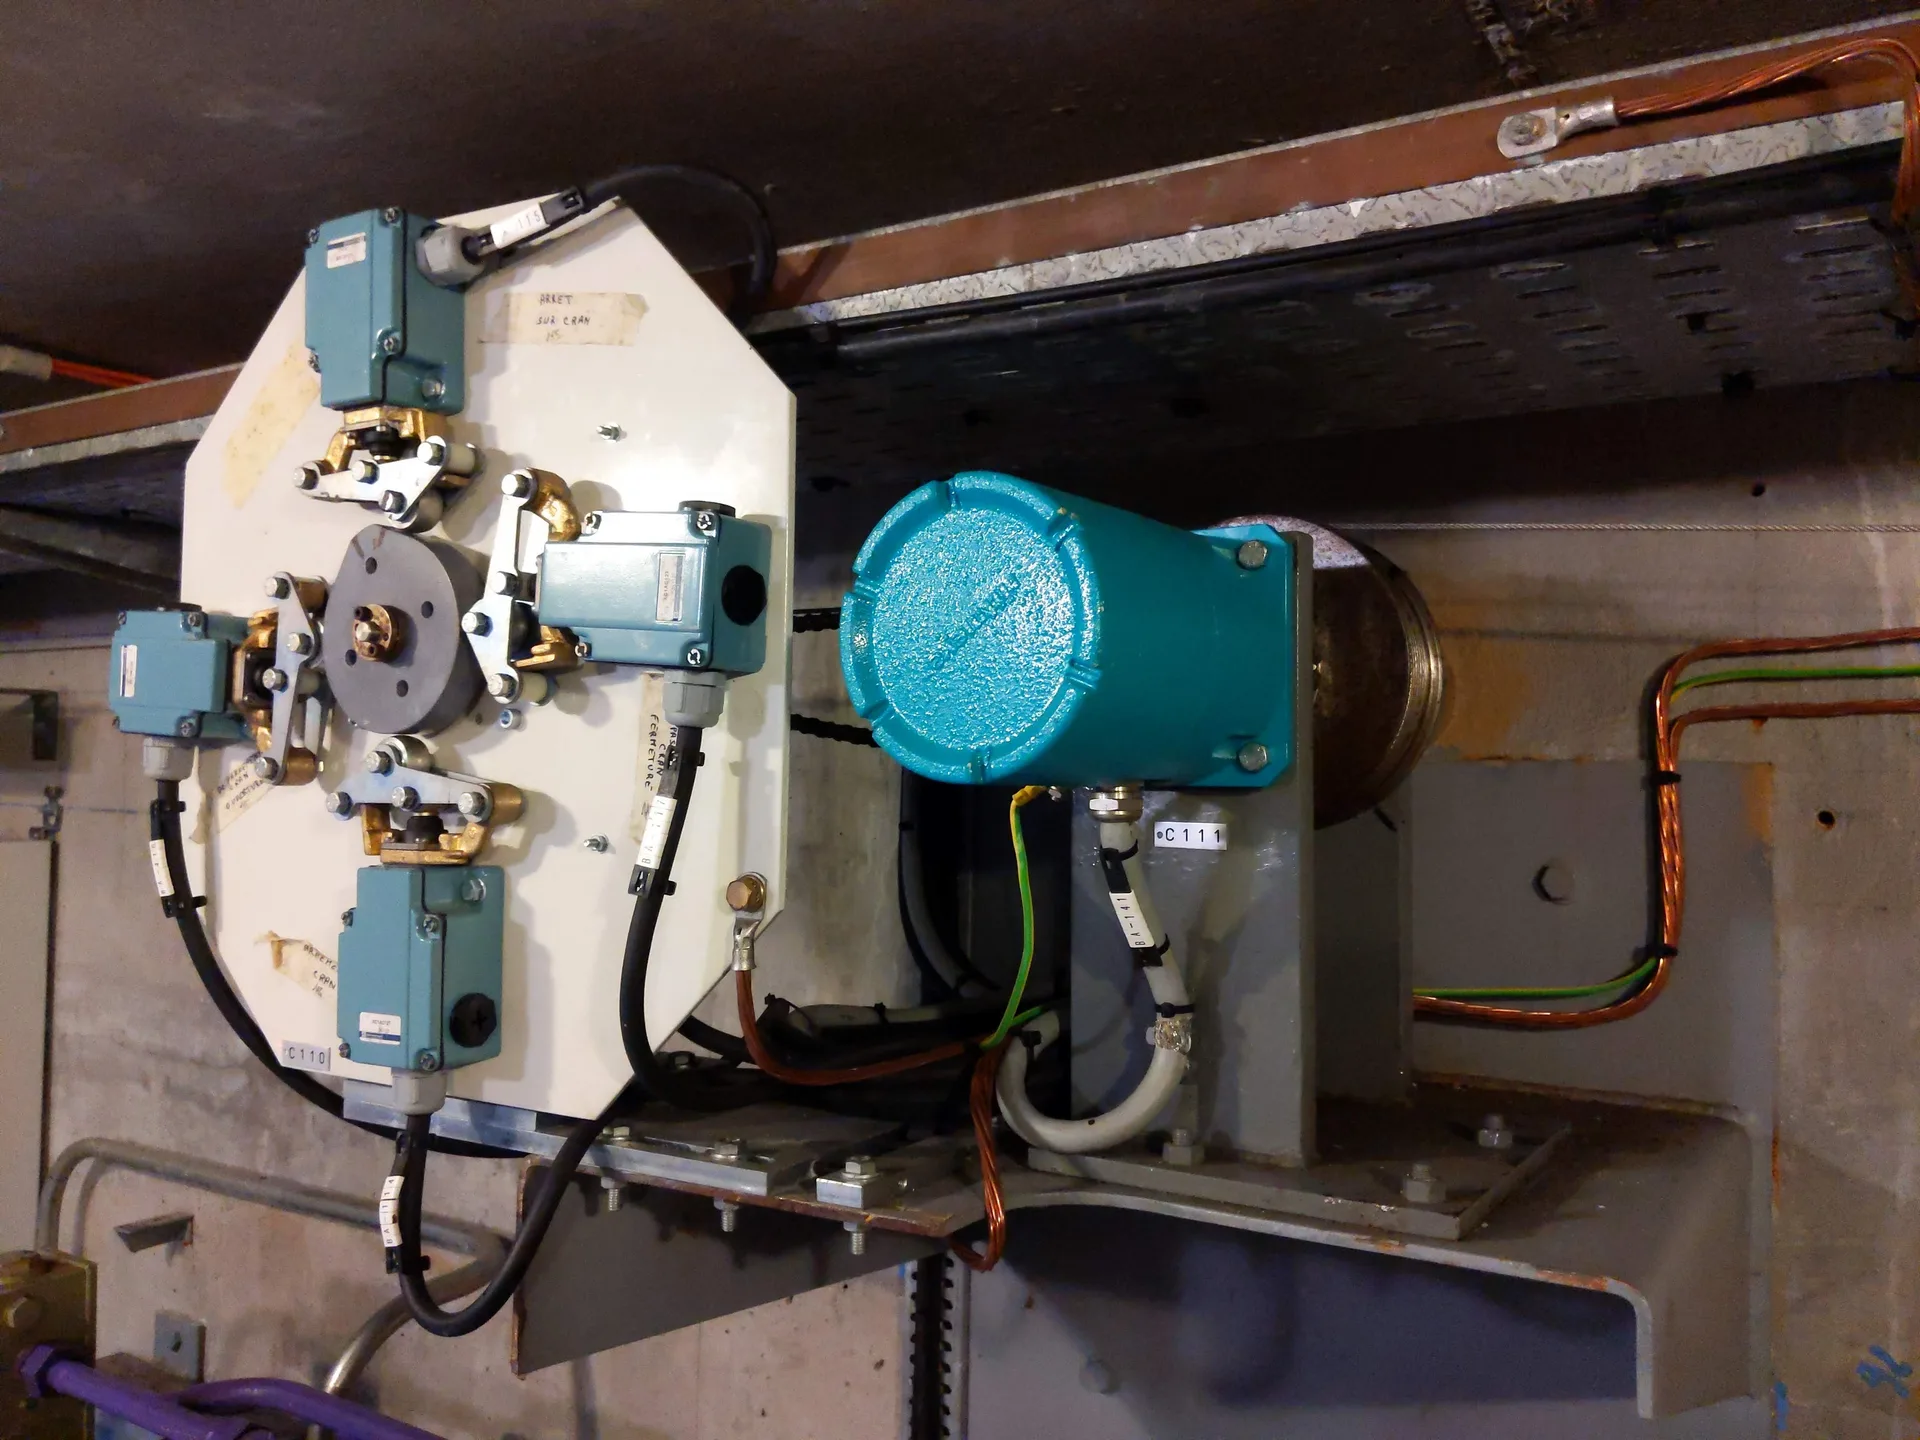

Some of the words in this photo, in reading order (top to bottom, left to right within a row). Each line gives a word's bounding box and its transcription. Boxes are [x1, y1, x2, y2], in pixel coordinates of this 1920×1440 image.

[539, 294, 574, 305] ARRET
[536, 316, 556, 326] SUR
[563, 315, 591, 326] CRAN
[644, 713, 660, 791] FERMETURE
[656, 743, 666, 776] CRAN
[1165, 827, 1221, 844] C111
[1116, 897, 1147, 946] BA-141
[288, 1046, 326, 1065] C110
